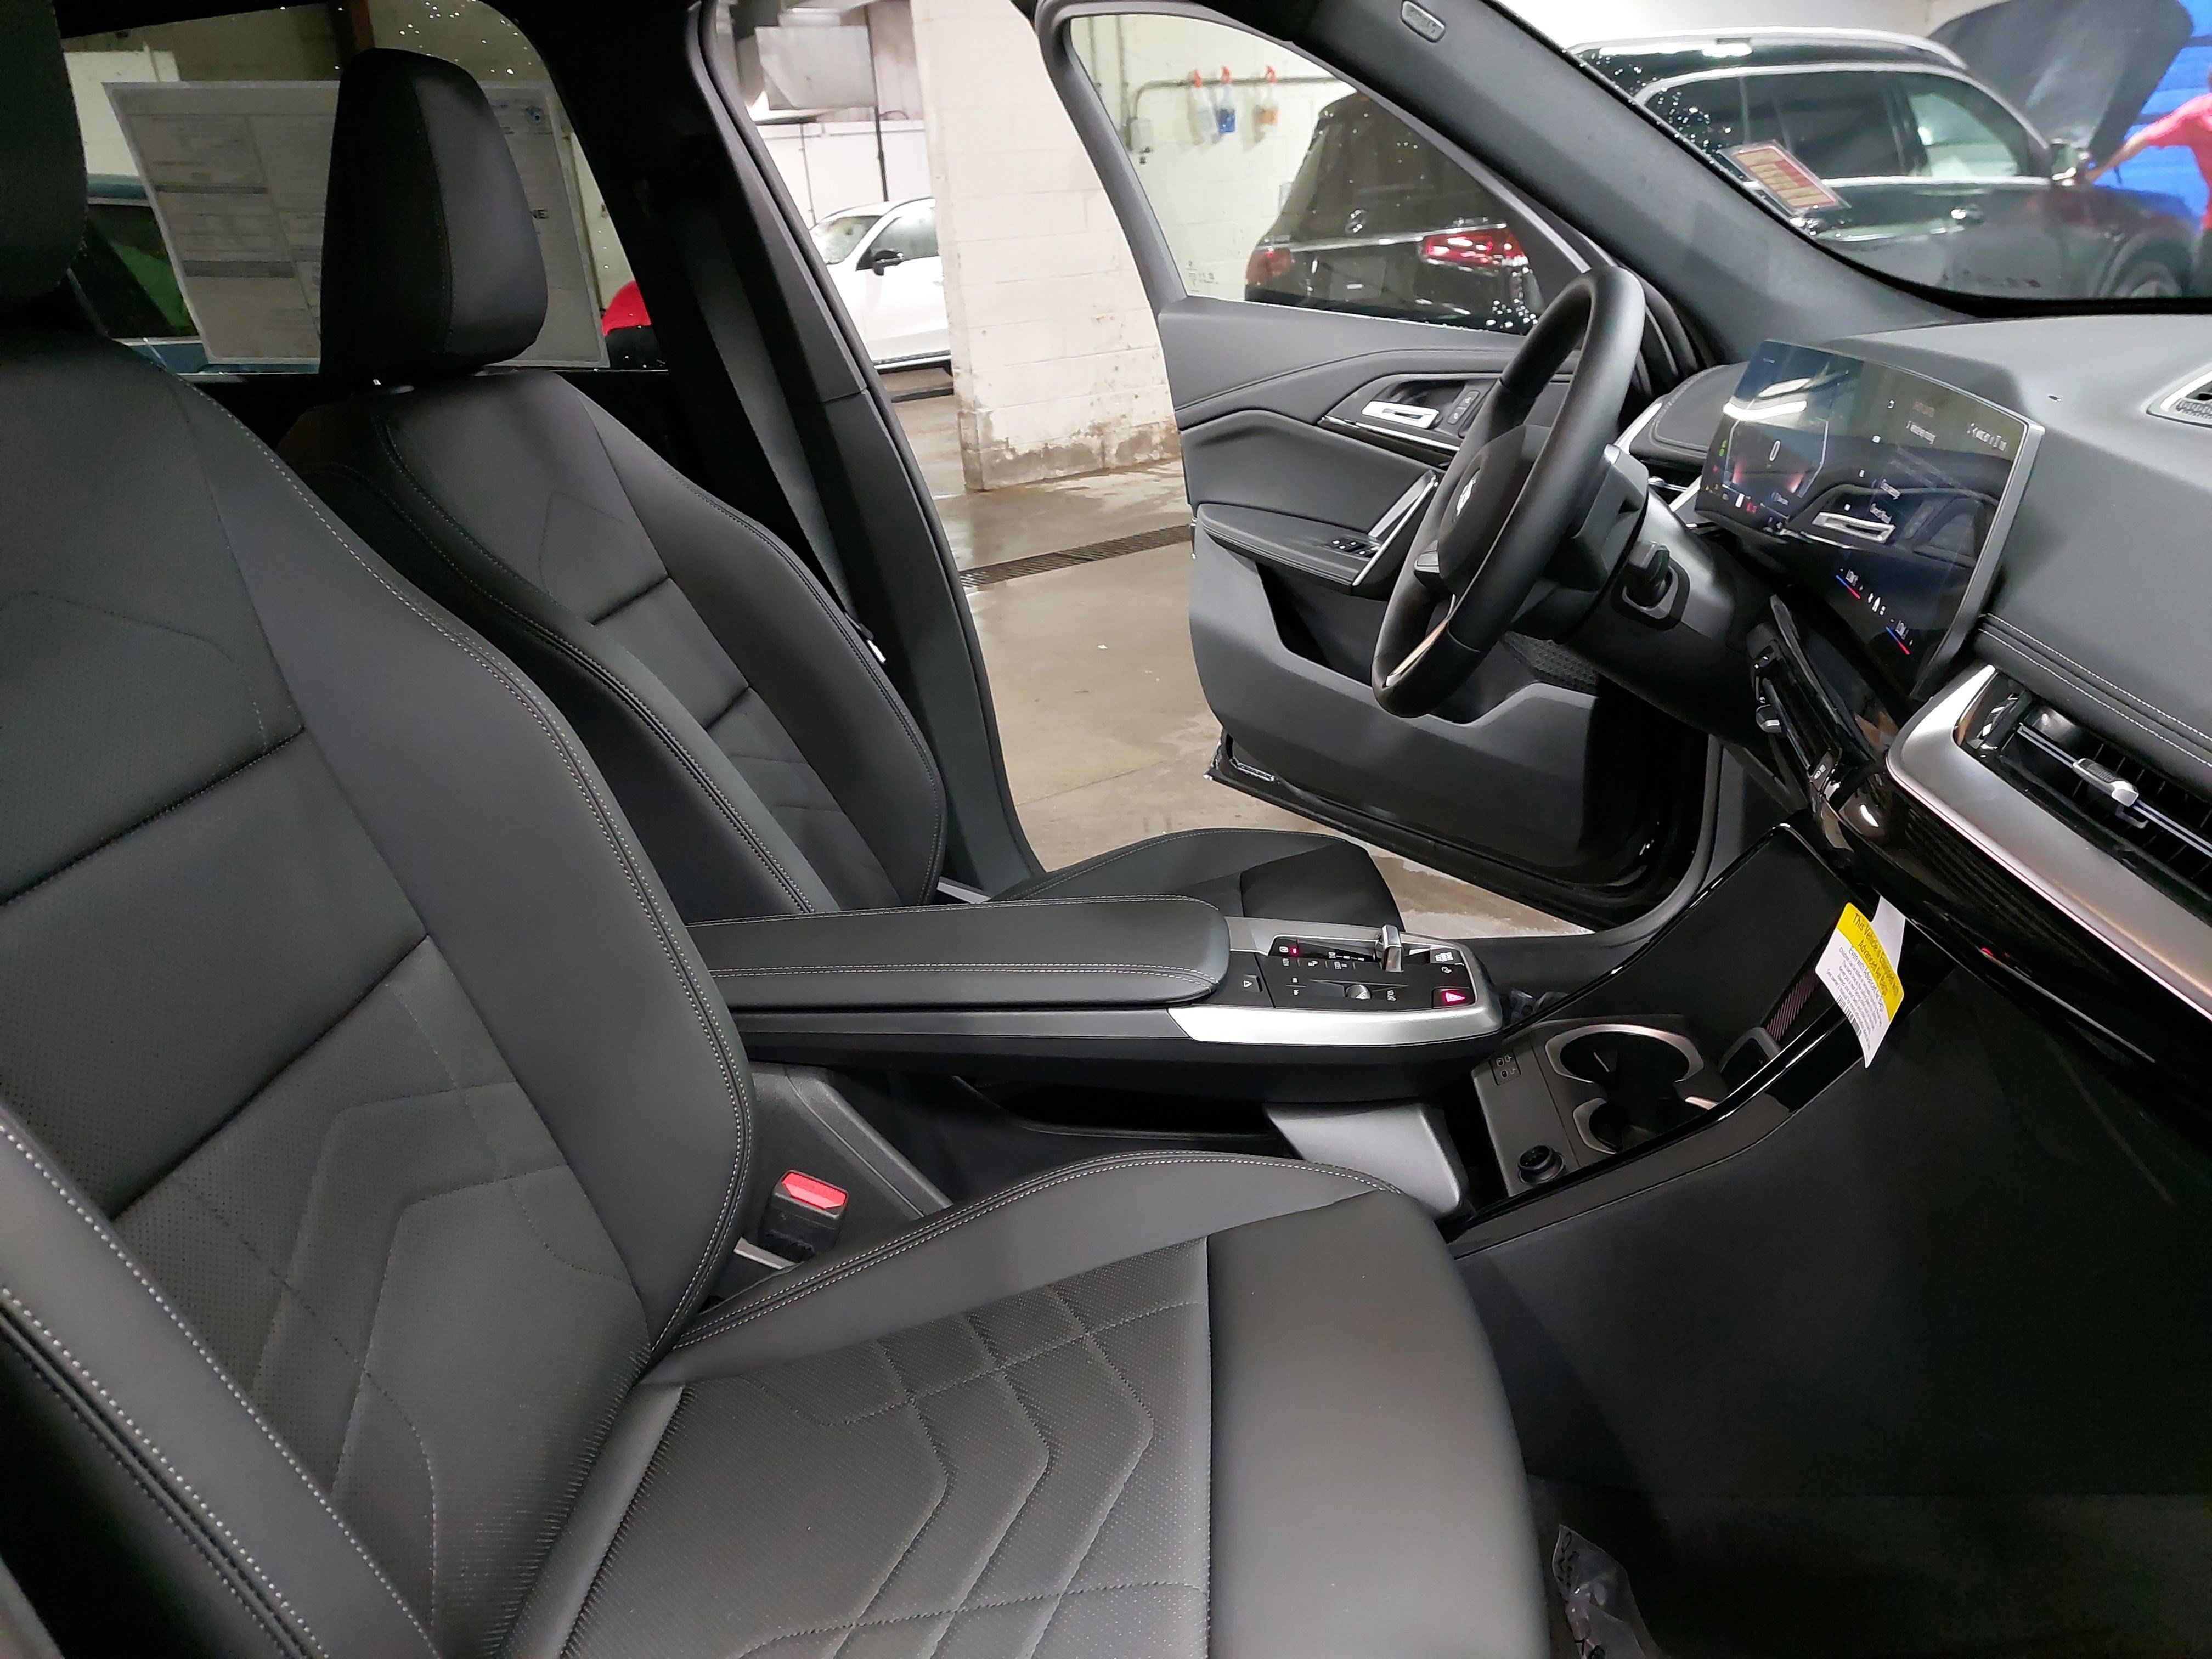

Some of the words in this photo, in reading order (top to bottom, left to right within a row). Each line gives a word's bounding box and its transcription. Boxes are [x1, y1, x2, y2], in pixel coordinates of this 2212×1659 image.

[1853, 912, 1865, 931] This
[1848, 946, 1858, 961] Even
[1858, 939, 1878, 971] Advanced
